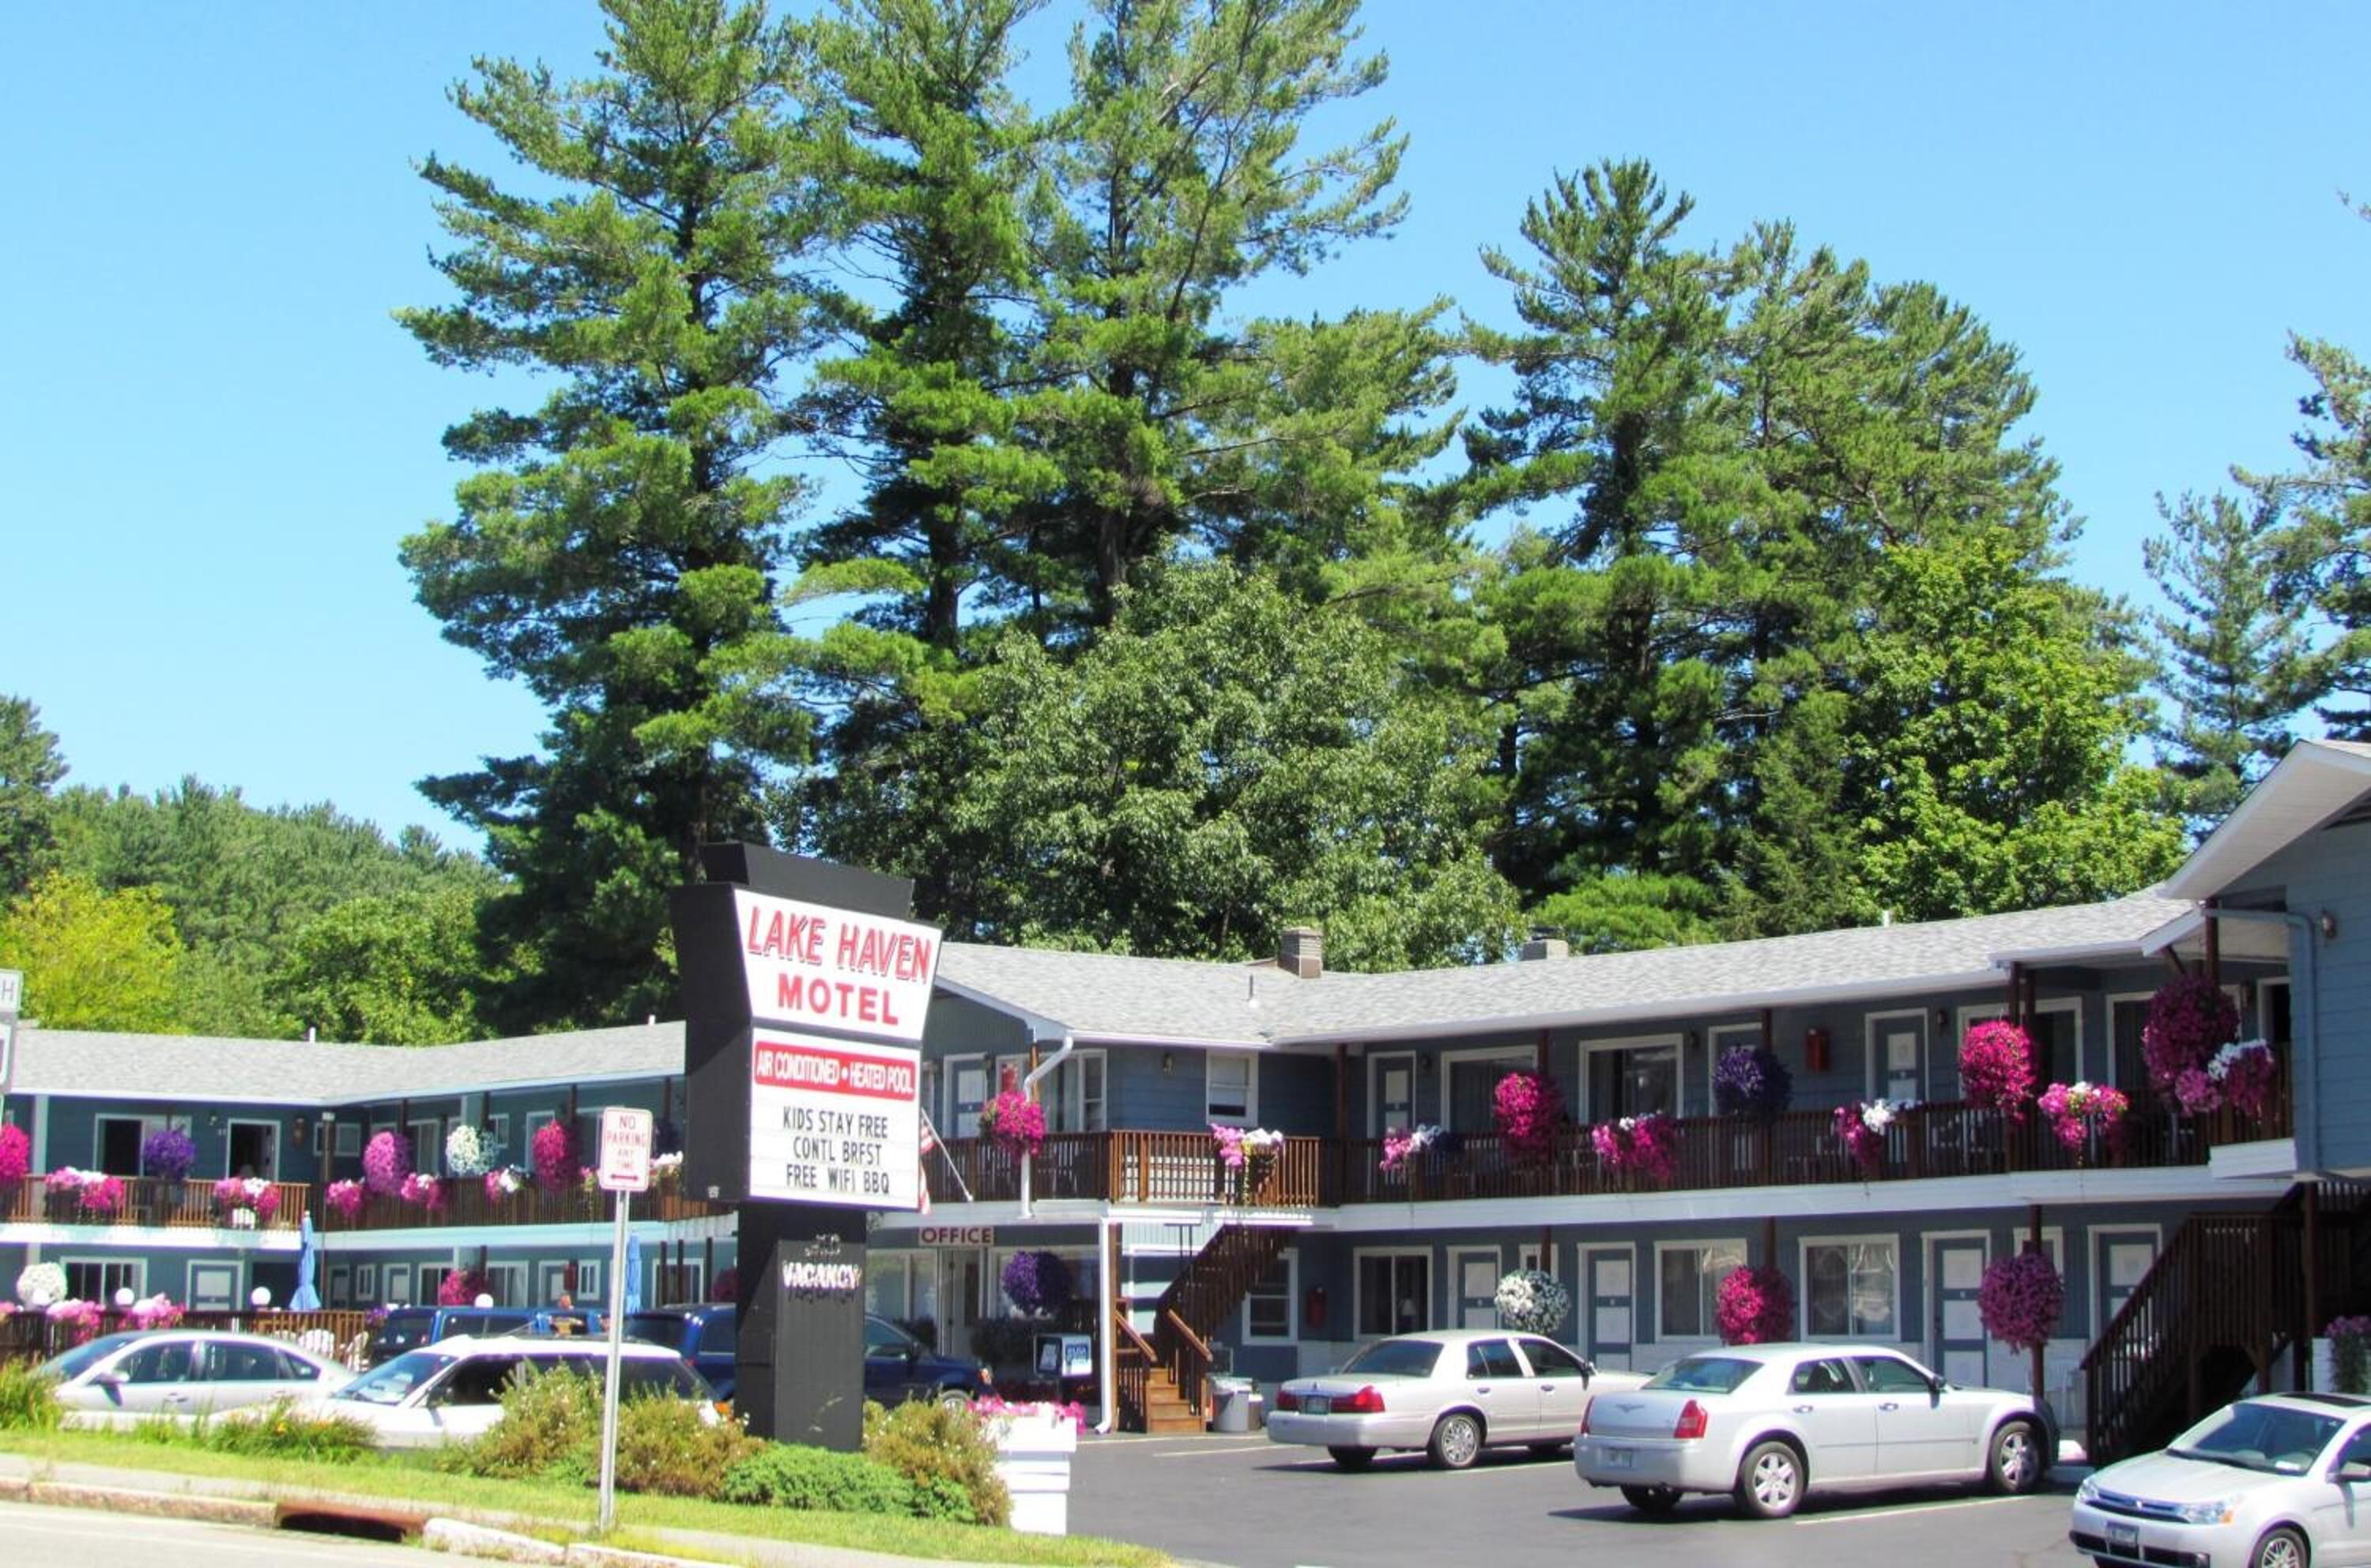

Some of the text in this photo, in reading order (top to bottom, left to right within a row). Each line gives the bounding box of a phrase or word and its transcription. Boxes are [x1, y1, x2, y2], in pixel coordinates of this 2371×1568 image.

[748, 906, 932, 985] LAKE HAVEN
[778, 973, 899, 1026] MOTEL
[757, 1050, 914, 1094] AIR CONDITIONED HEATED POOL
[619, 1114, 636, 1130] NO
[783, 1106, 888, 1138] KIDS STAY FREE
[606, 1130, 646, 1148] PARKING
[793, 1136, 883, 1166] CONTL BRFST
[786, 1163, 890, 1194] FREE WIFI BBQ
[922, 1227, 992, 1244] OFFICE
[782, 1261, 862, 1290] VACANCY
